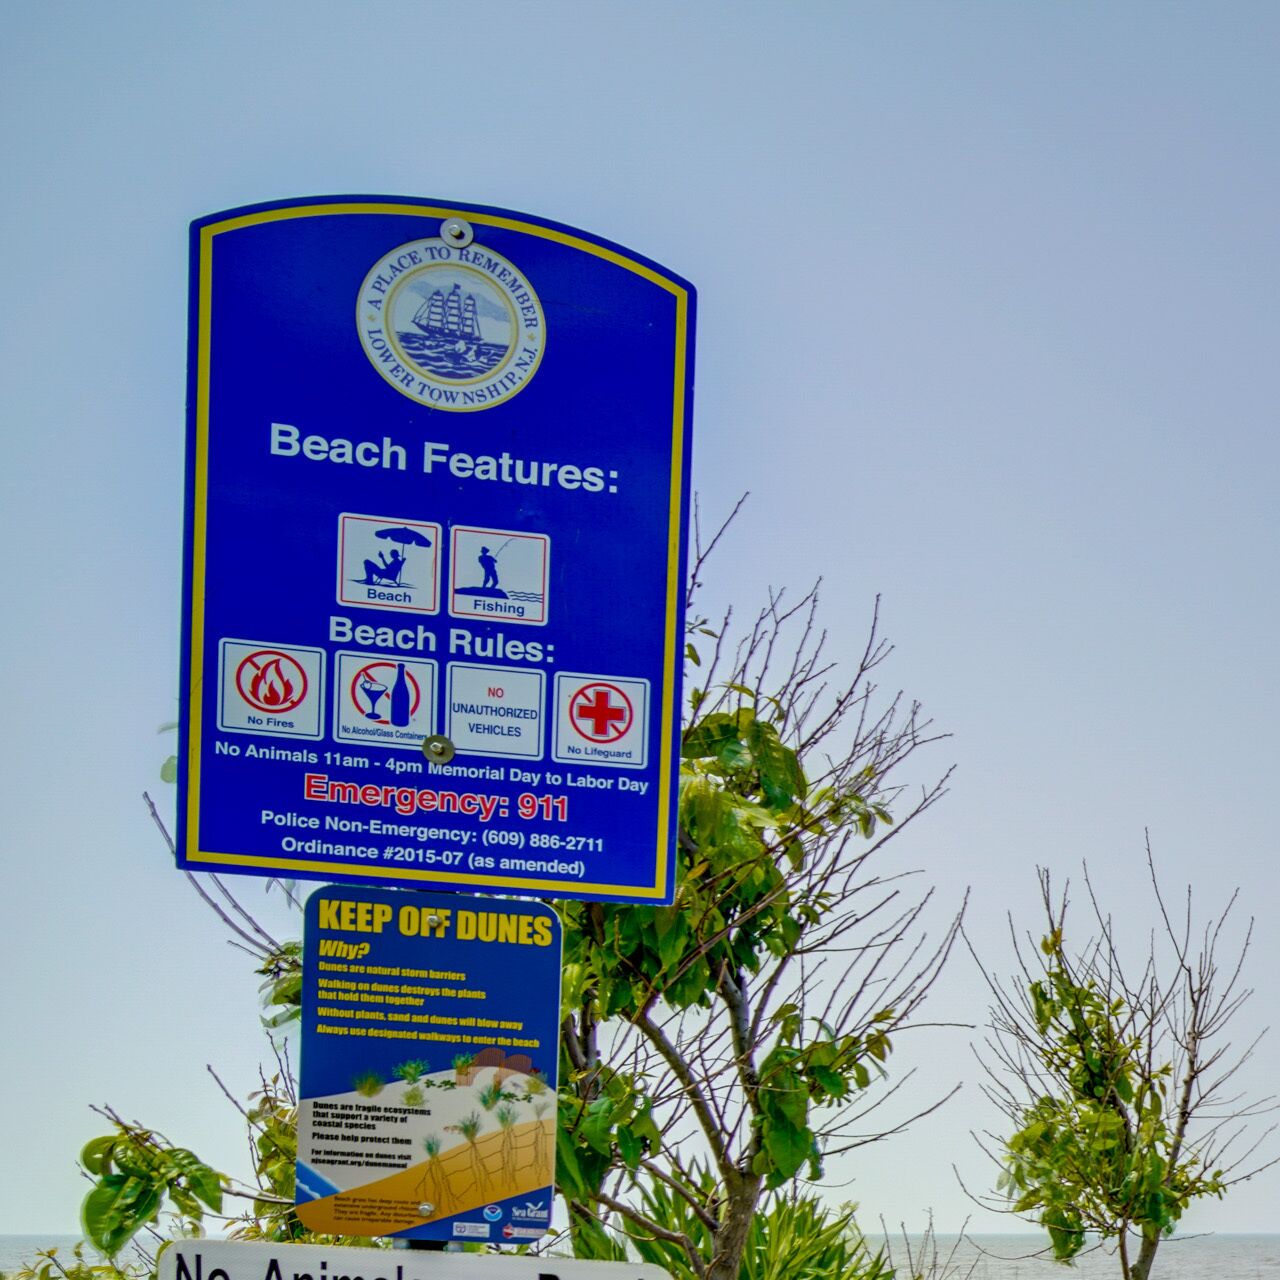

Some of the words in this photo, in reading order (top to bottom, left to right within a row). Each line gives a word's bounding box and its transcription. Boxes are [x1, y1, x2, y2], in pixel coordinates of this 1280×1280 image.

[425, 246, 450, 260] TO
[372, 250, 422, 294] PLACE
[458, 248, 538, 328] REMEMBER
[368, 298, 382, 311] A
[368, 328, 415, 388] LOWER
[418, 371, 523, 405] TOWNSHIP,
[270, 423, 406, 470] Beach
[423, 442, 618, 493] Features:
[367, 588, 411, 604] Beach
[473, 600, 525, 617] Fishing
[329, 616, 436, 651] Beach
[449, 628, 554, 662] Rules:
[488, 687, 504, 698] NO
[452, 702, 538, 720] UNAUTHORIZED
[247, 716, 263, 725] No
[267, 718, 294, 729] Fires
[468, 722, 522, 737] VEHICLES
[342, 725, 351, 734] No
[352, 726, 394, 738] Alcohol/Glass
[395, 730, 427, 740] Containers
[567, 745, 581, 755] No
[584, 747, 632, 760] Lifeguard
[215, 741, 240, 756] No
[245, 744, 318, 764] Animals
[324, 752, 369, 768] 11am
[385, 757, 423, 774] 4pm
[428, 762, 504, 781] Memorial
[510, 768, 541, 786] Day
[545, 771, 562, 785] to
[566, 773, 614, 790] Labor
[618, 777, 649, 794] Day
[304, 773, 509, 822] Emergency:
[518, 792, 568, 822] 911
[261, 810, 320, 829] Police
[325, 815, 477, 845] Non-Emergency:
[482, 829, 525, 849] (609)
[530, 834, 603, 852] 886-2711
[281, 837, 379, 859] Ordinance
[383, 846, 463, 866] #2015-07
[468, 853, 495, 870] (as
[500, 858, 585, 878] amended)
[319, 899, 393, 933] KEEP
[399, 905, 451, 938] OFF
[457, 910, 553, 947] DUNES
[319, 939, 370, 960] Why?
[319, 961, 348, 972] Dunes
[349, 965, 365, 973] are
[366, 965, 400, 976] natural
[401, 968, 428, 978] storm
[429, 970, 466, 981] barriers
[318, 978, 357, 990] Walking
[358, 982, 370, 991] on
[371, 983, 400, 993] dunes
[400, 985, 440, 996] destroys
[441, 988, 456, 997] the
[457, 989, 486, 999] plants
[318, 990, 337, 1000] that
[338, 991, 359, 1001] hold
[360, 993, 384, 1003] them
[385, 995, 425, 1006] together
[317, 1007, 354, 1018] Without
[387, 1013, 410, 1022] sand
[411, 1014, 429, 1023] and
[430, 1015, 458, 1025] dunes
[459, 1017, 476, 1026] will
[477, 1018, 499, 1028] blow
[499, 1021, 523, 1031] away
[317, 1024, 348, 1035] Always
[350, 1027, 366, 1036] use
[367, 1027, 417, 1039] designated
[419, 1031, 461, 1043] walkways
[462, 1035, 471, 1043] to
[473, 1036, 496, 1045] enter
[497, 1037, 512, 1046] the
[513, 1038, 540, 1047] beach
[313, 1101, 338, 1110] Dunes
[340, 1103, 353, 1111] are
[355, 1104, 381, 1113] fragile
[384, 1106, 431, 1116] ecosystems
[313, 1110, 329, 1118] that
[331, 1112, 362, 1121] support
[370, 1114, 397, 1123] variety
[312, 1120, 342, 1128] coastal
[344, 1121, 376, 1130] species
[312, 1132, 339, 1140] Please
[341, 1133, 359, 1142] help
[360, 1135, 390, 1144] protect
[392, 1136, 412, 1145] them
[323, 1149, 363, 1158] information
[375, 1152, 396, 1160] dunes
